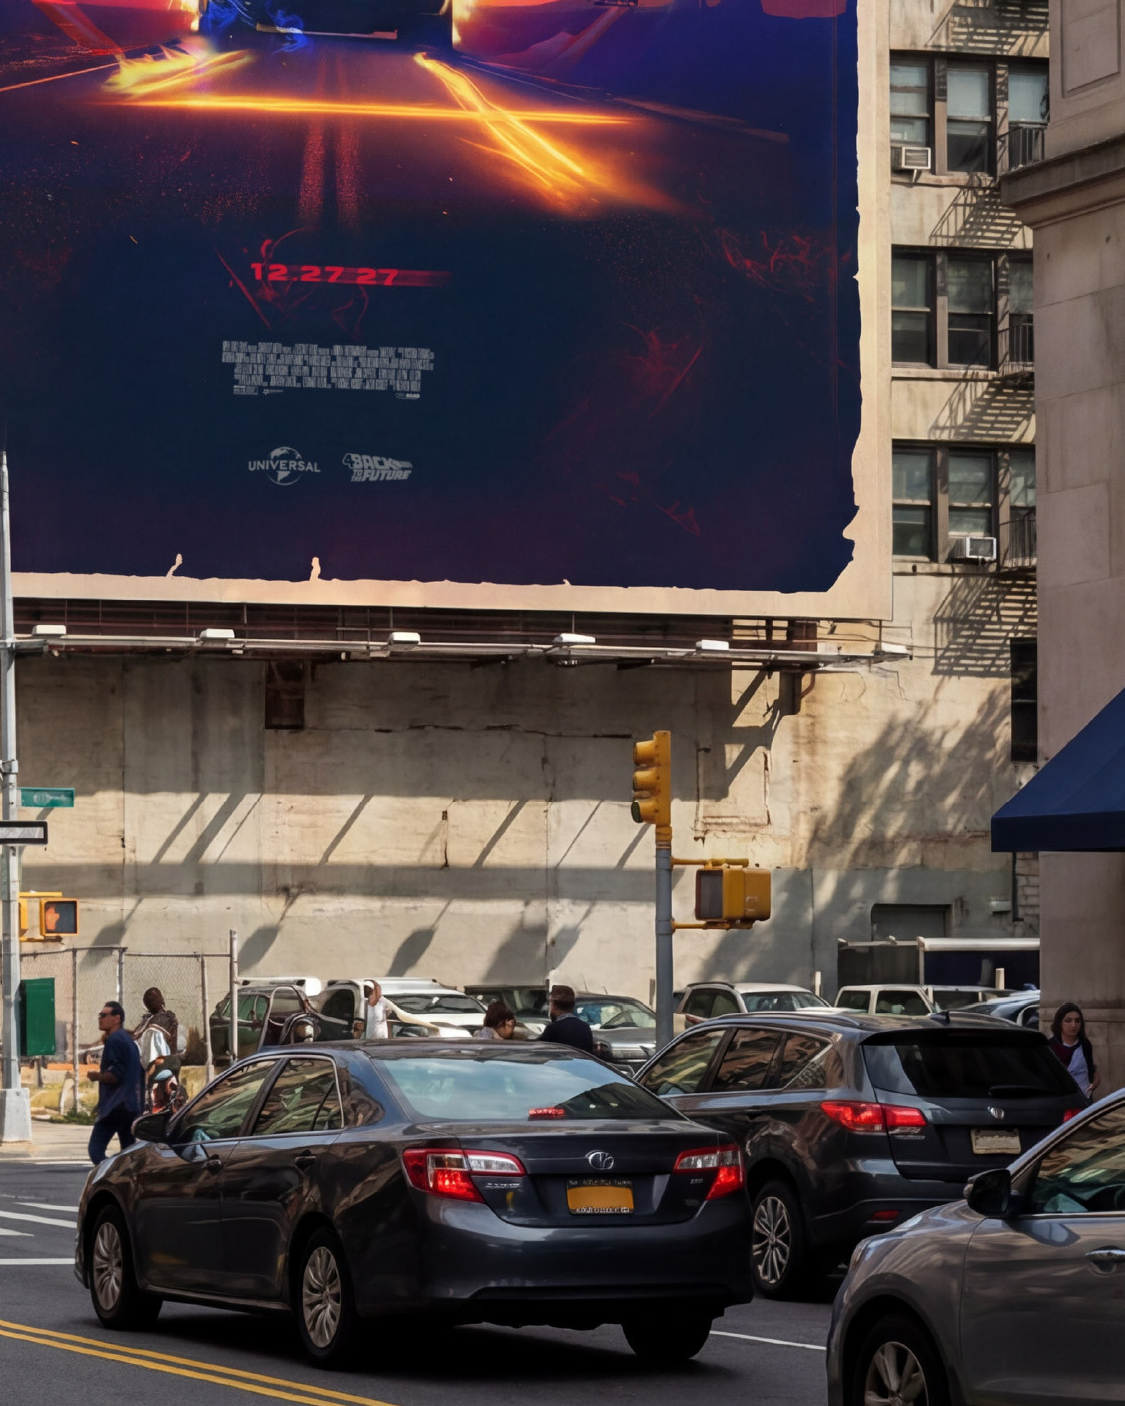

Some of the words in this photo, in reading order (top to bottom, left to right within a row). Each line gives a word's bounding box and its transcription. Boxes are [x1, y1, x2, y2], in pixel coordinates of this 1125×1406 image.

[248, 460, 321, 473] UNIVERSAL
[351, 453, 413, 470] BACK
[362, 469, 412, 482] FUTURE
